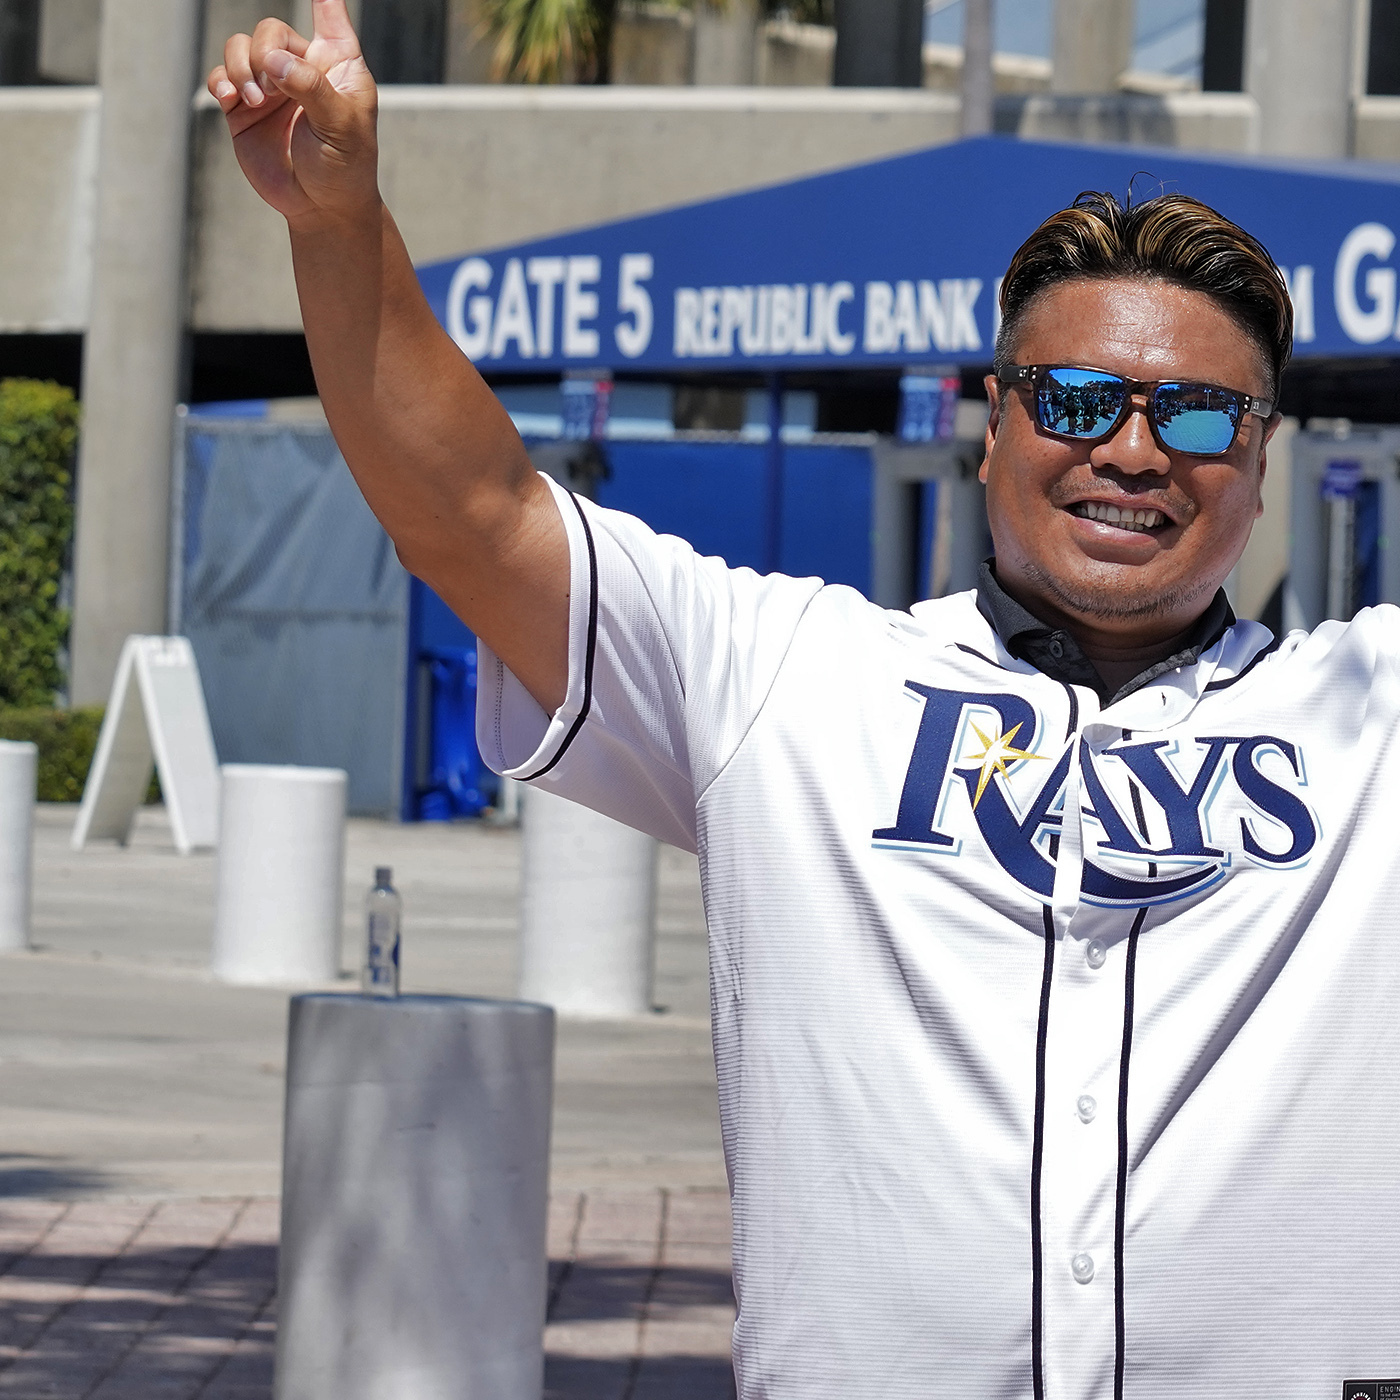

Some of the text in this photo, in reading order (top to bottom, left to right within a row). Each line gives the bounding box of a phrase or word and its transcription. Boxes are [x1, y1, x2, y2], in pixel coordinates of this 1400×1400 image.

[446, 255, 601, 362] GATE
[614, 252, 654, 359] 5
[673, 281, 856, 358] REPUBLIC
[863, 277, 984, 353] BANK
[871, 679, 1323, 908] RAYS
